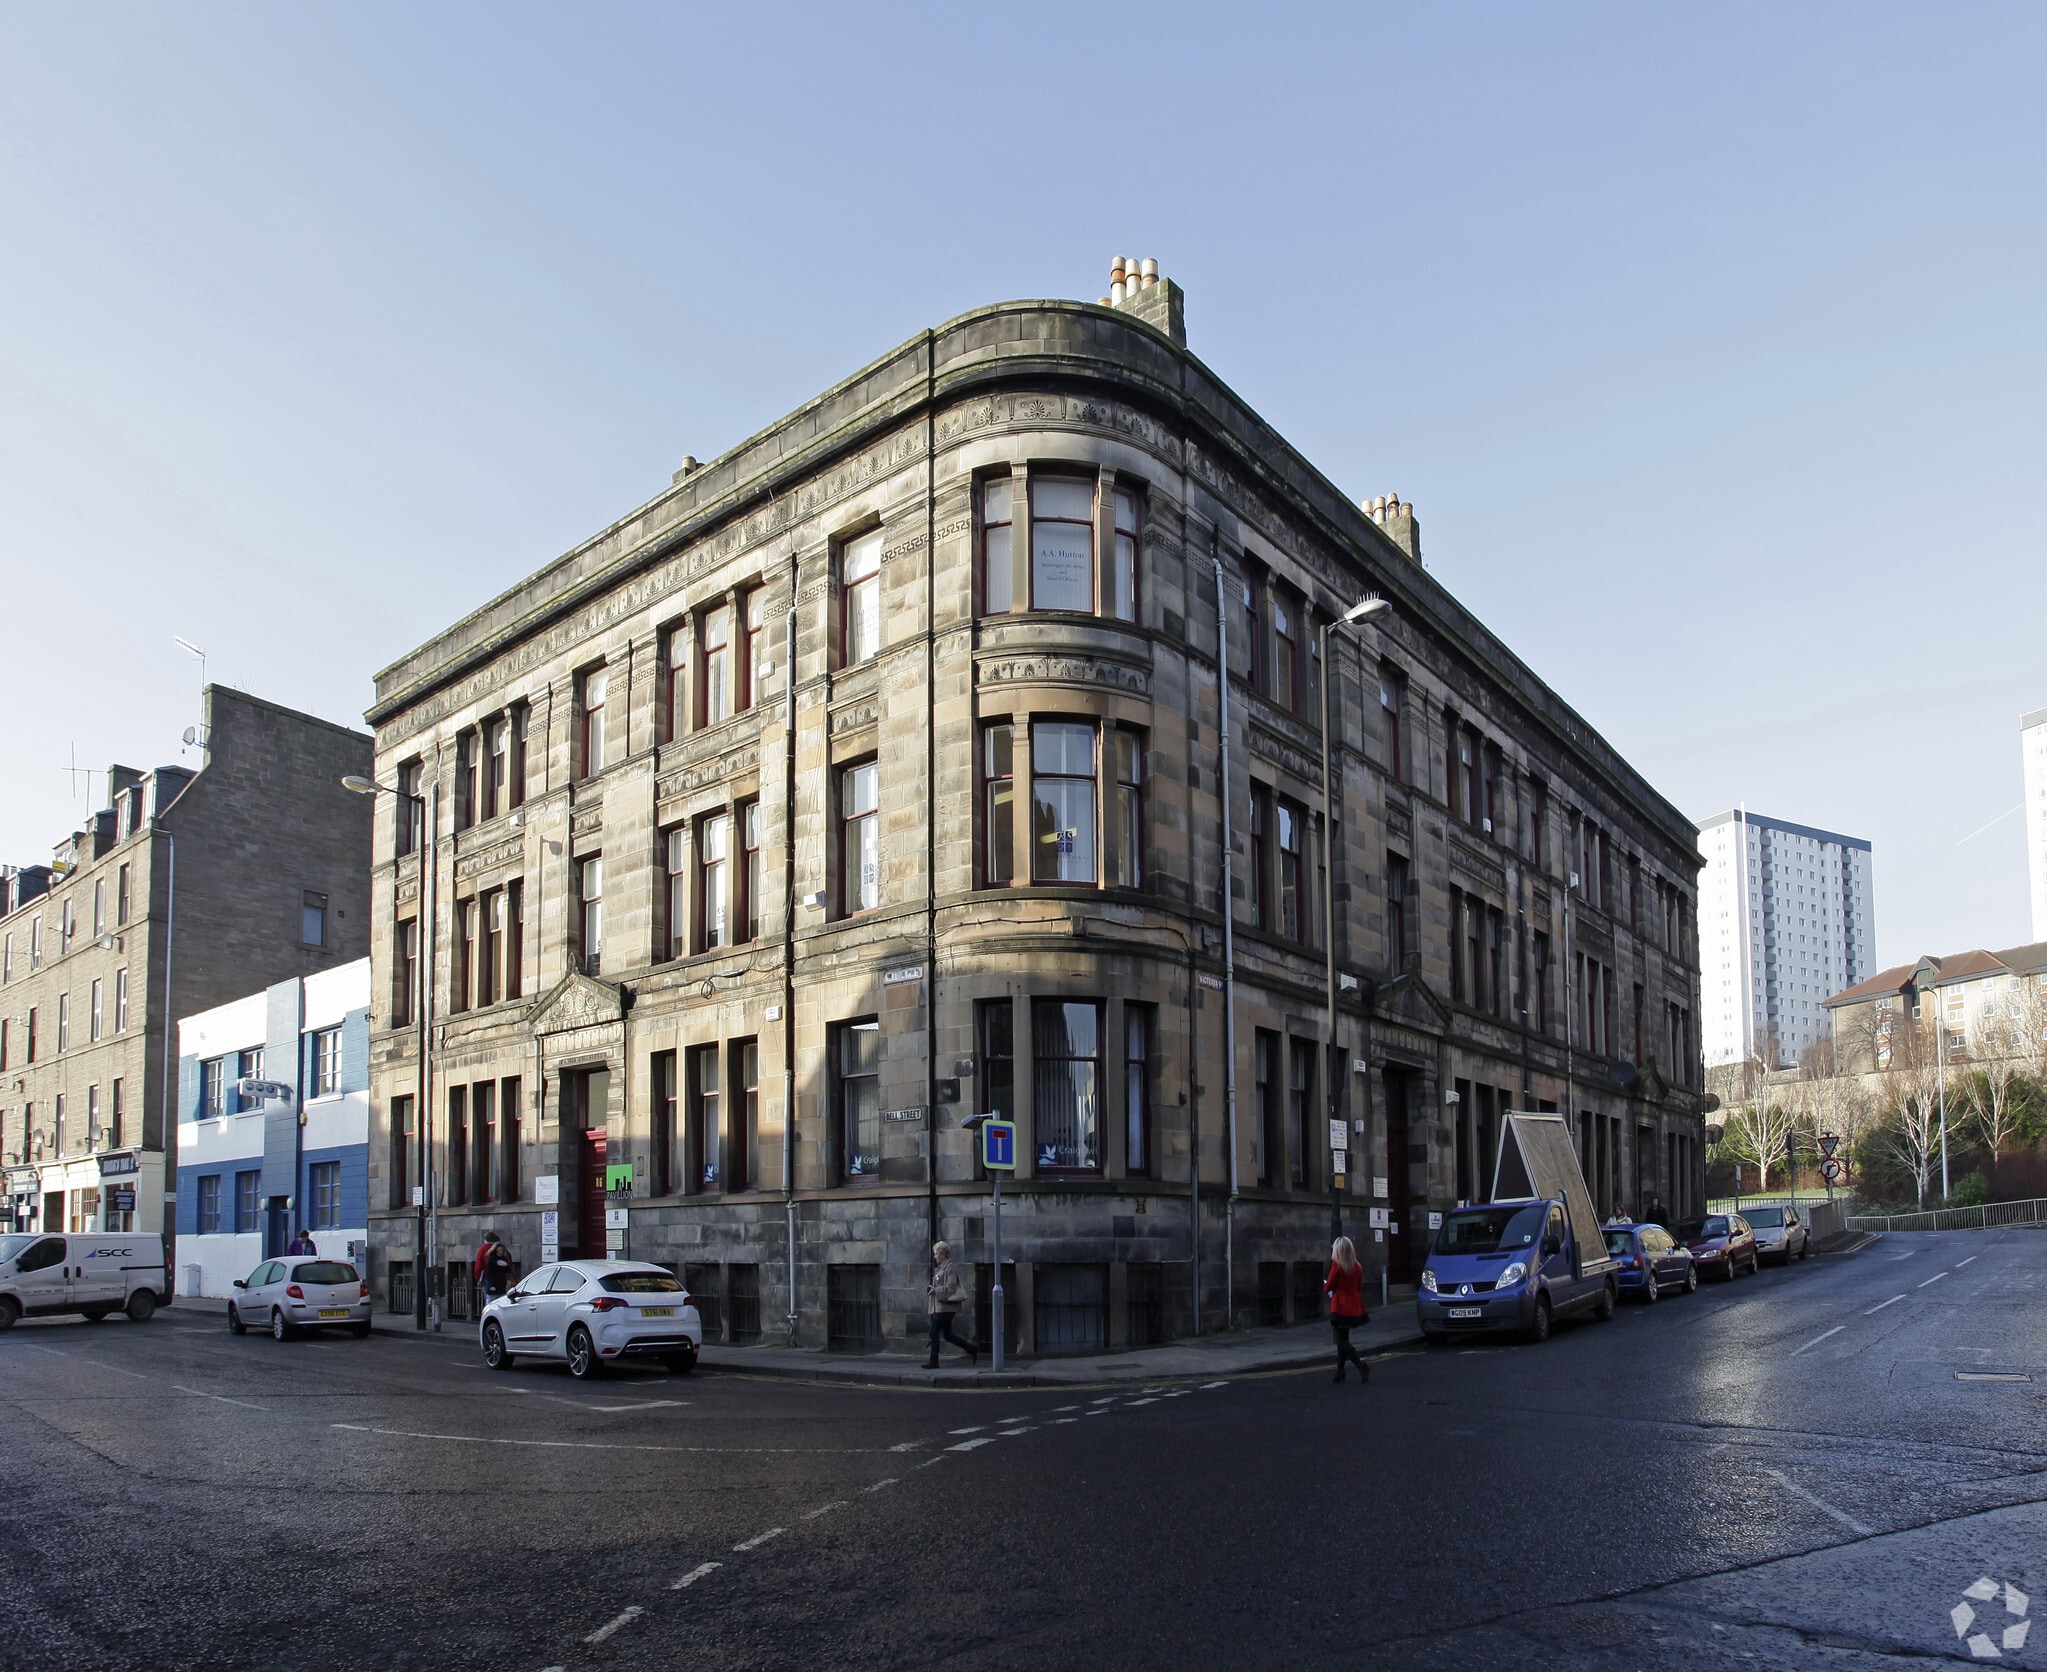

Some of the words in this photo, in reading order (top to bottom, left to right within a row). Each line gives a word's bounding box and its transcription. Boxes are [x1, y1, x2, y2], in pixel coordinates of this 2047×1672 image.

[1058, 550, 1085, 559] Hutton
[885, 1111, 899, 1121] BELL
[899, 1109, 921, 1120] STREET
[98, 1249, 133, 1258] SCC
